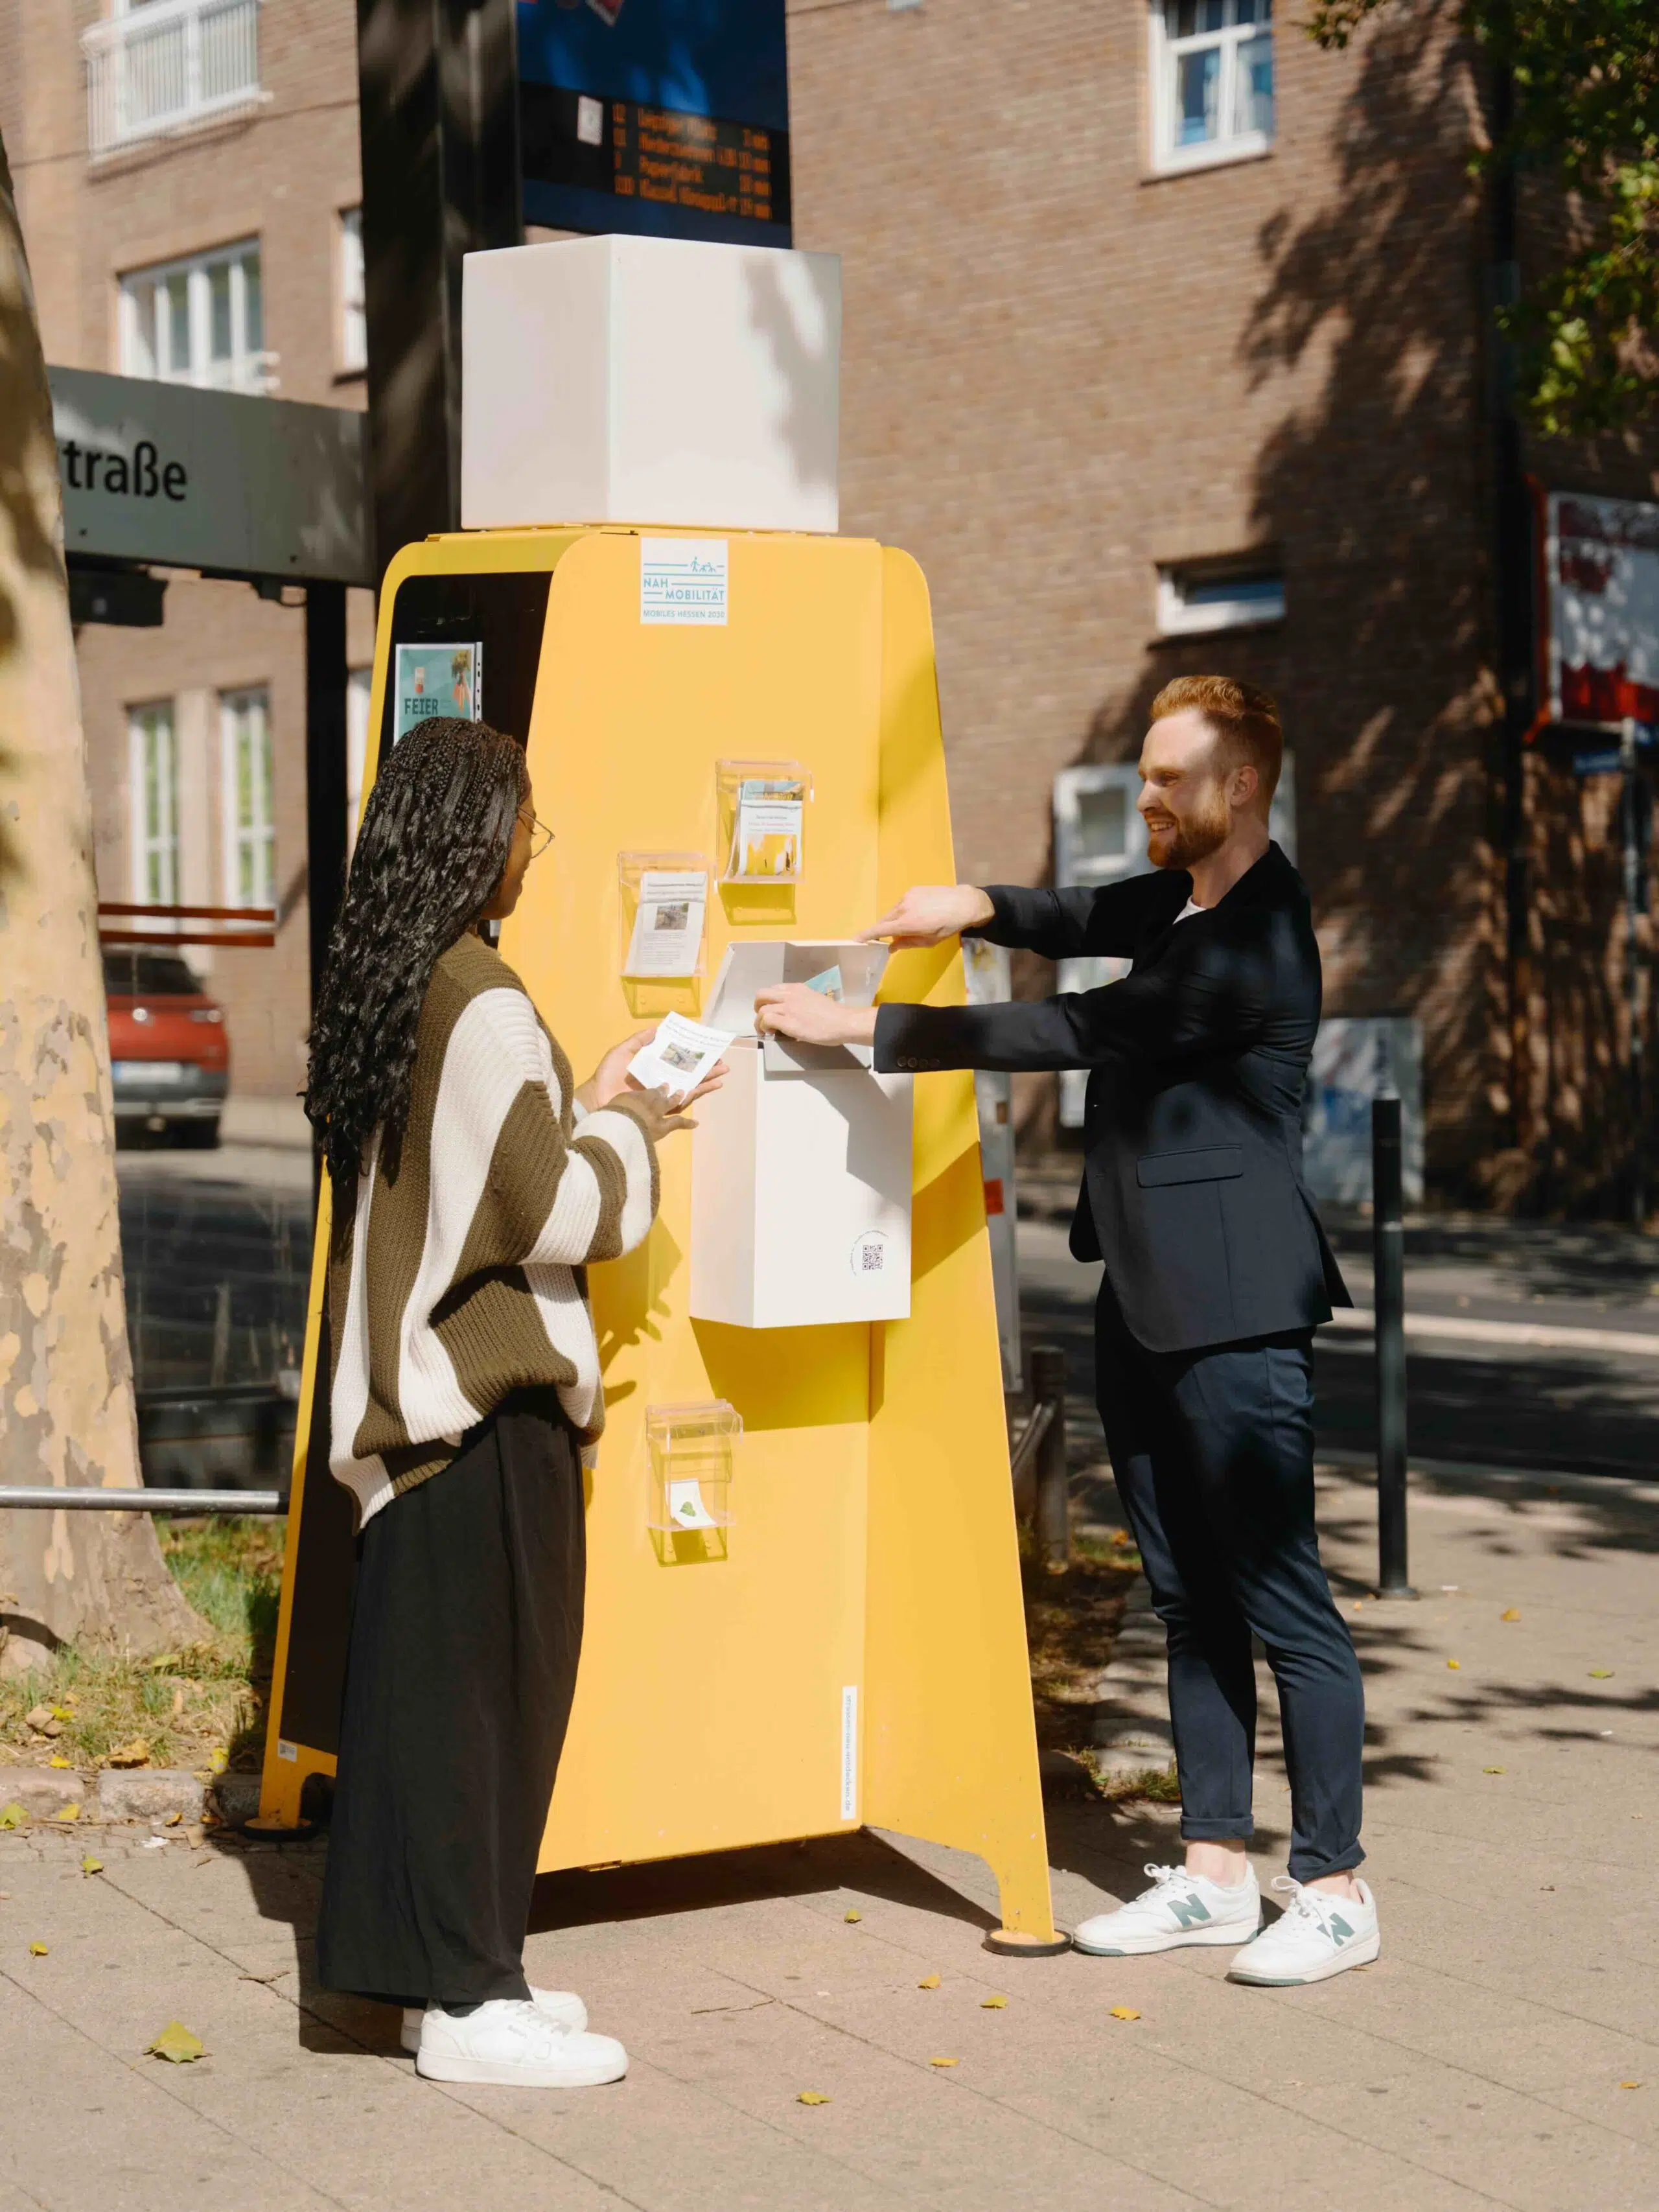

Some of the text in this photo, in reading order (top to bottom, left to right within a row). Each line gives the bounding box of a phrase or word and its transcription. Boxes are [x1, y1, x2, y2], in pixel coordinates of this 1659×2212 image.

[62, 440, 187, 502] traße
[644, 577, 668, 588] NAH
[666, 588, 725, 600] MOBILITÄT
[677, 610, 705, 618] HESSEN
[404, 697, 439, 716] FEIER
[1166, 1893, 1212, 1928] N
